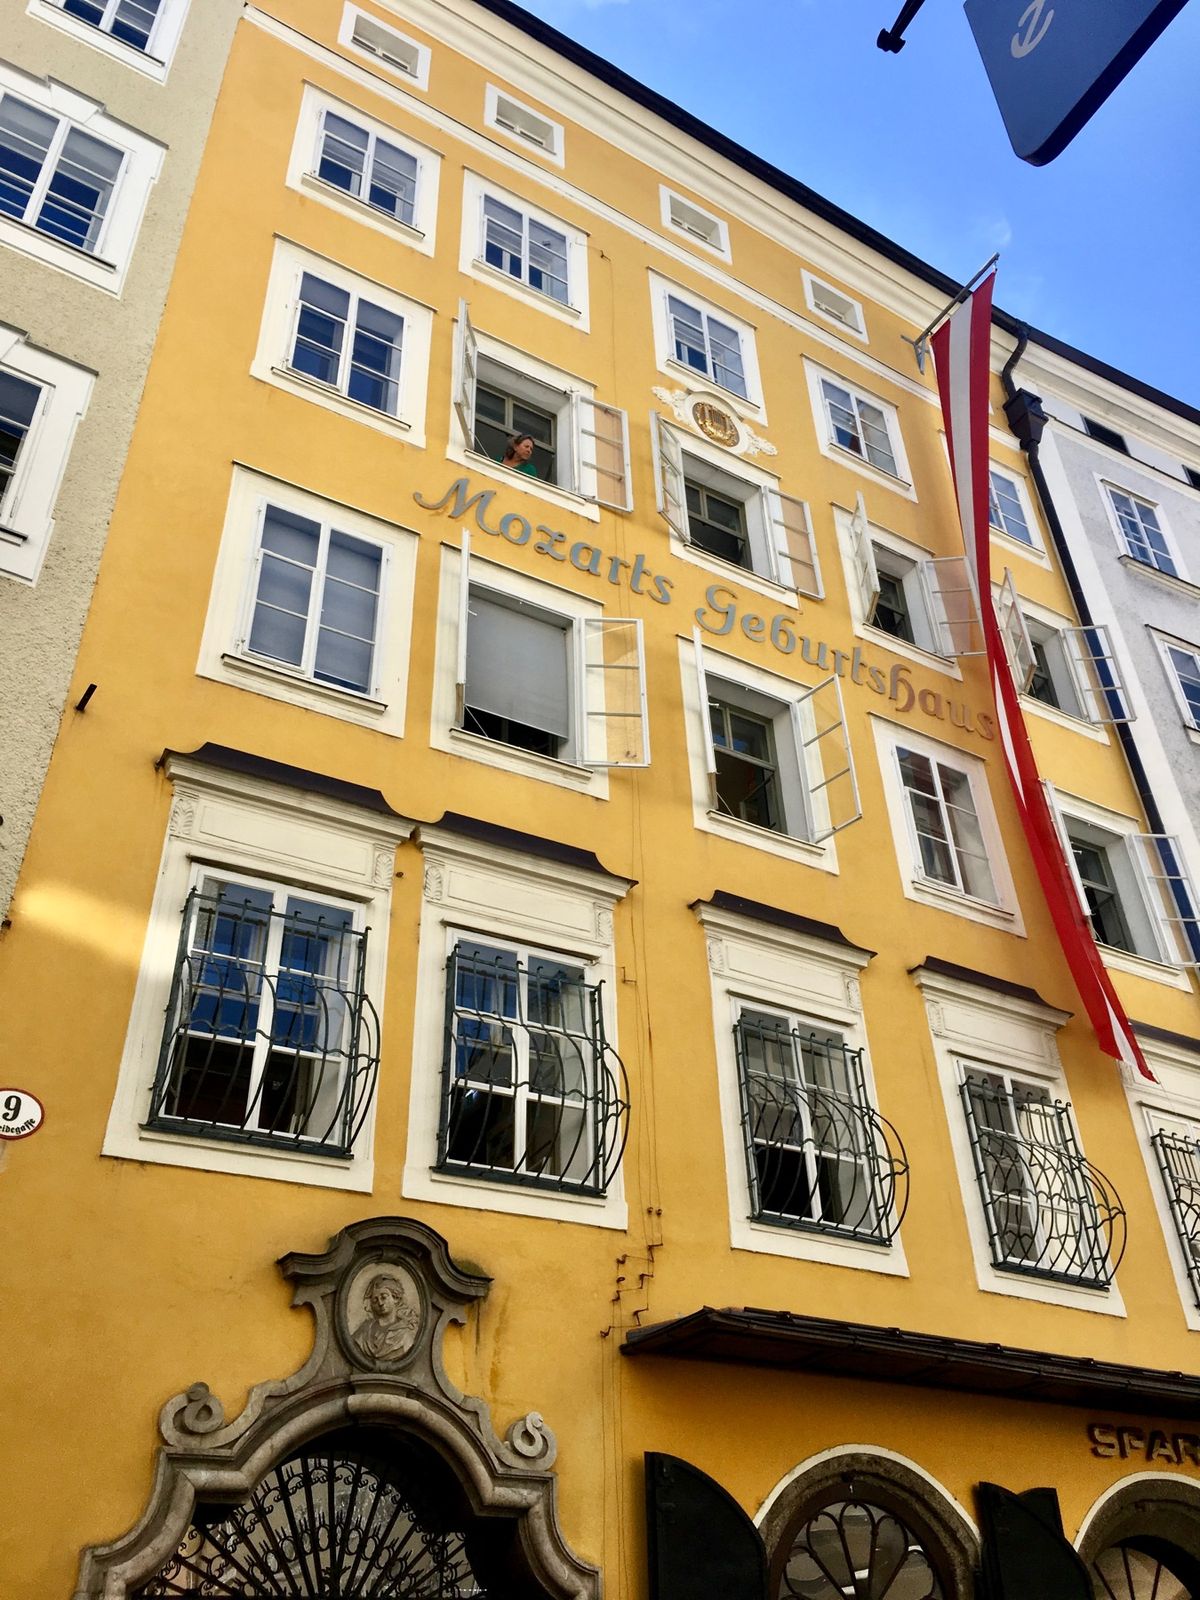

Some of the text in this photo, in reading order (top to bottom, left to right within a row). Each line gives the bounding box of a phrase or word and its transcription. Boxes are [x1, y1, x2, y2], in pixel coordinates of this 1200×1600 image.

[413, 477, 995, 741] Mozarts Geburtshaus
[2, 1095, 22, 1122] 9
[1087, 1423, 1200, 1467] SPAR
